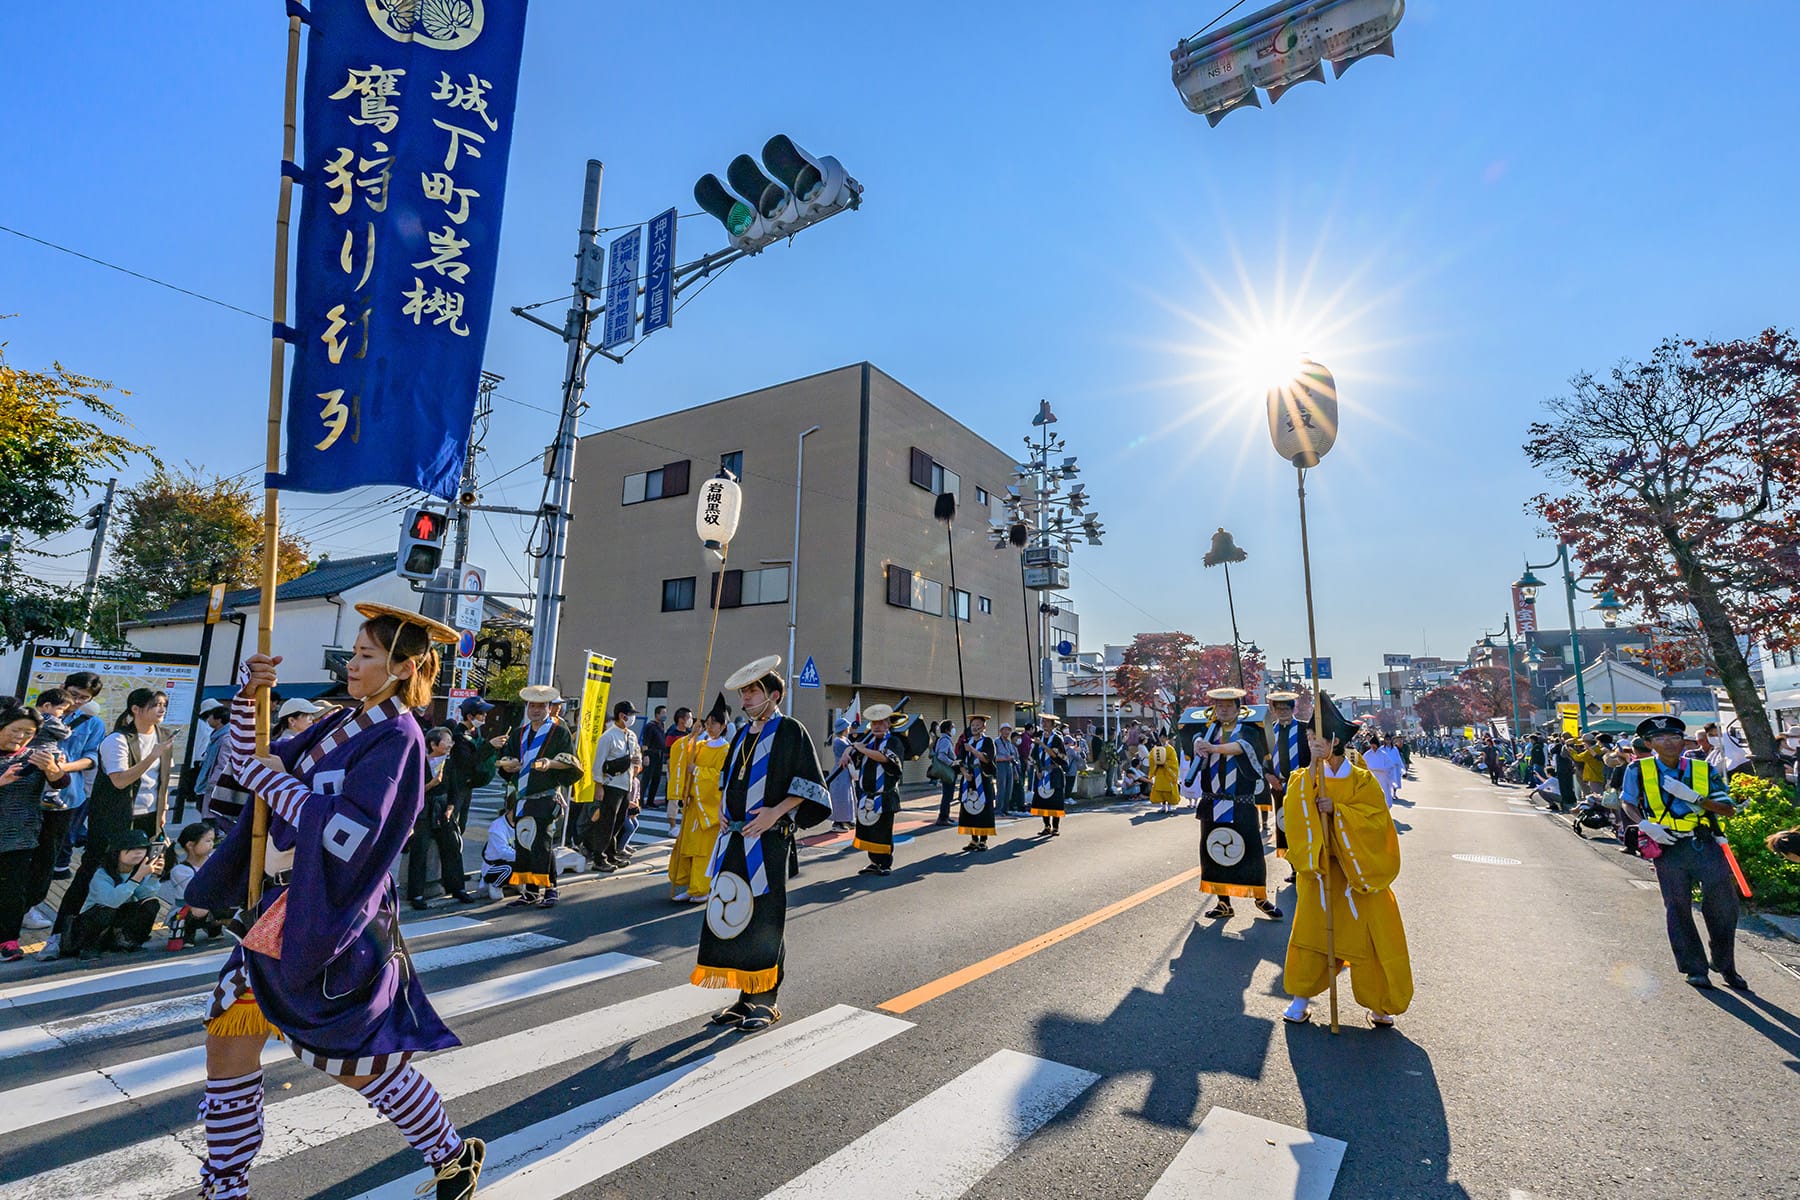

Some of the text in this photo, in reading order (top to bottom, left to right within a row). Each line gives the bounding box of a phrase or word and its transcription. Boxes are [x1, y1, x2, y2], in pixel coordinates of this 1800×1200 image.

[1207, 63, 1232, 79] NS 18
[313, 64, 406, 451] 鷹狩り行列
[401, 71, 498, 337] 城下町岩槻
[649, 217, 667, 324] 押ボタン信号
[704, 483, 724, 526] 岩槻黒奴
